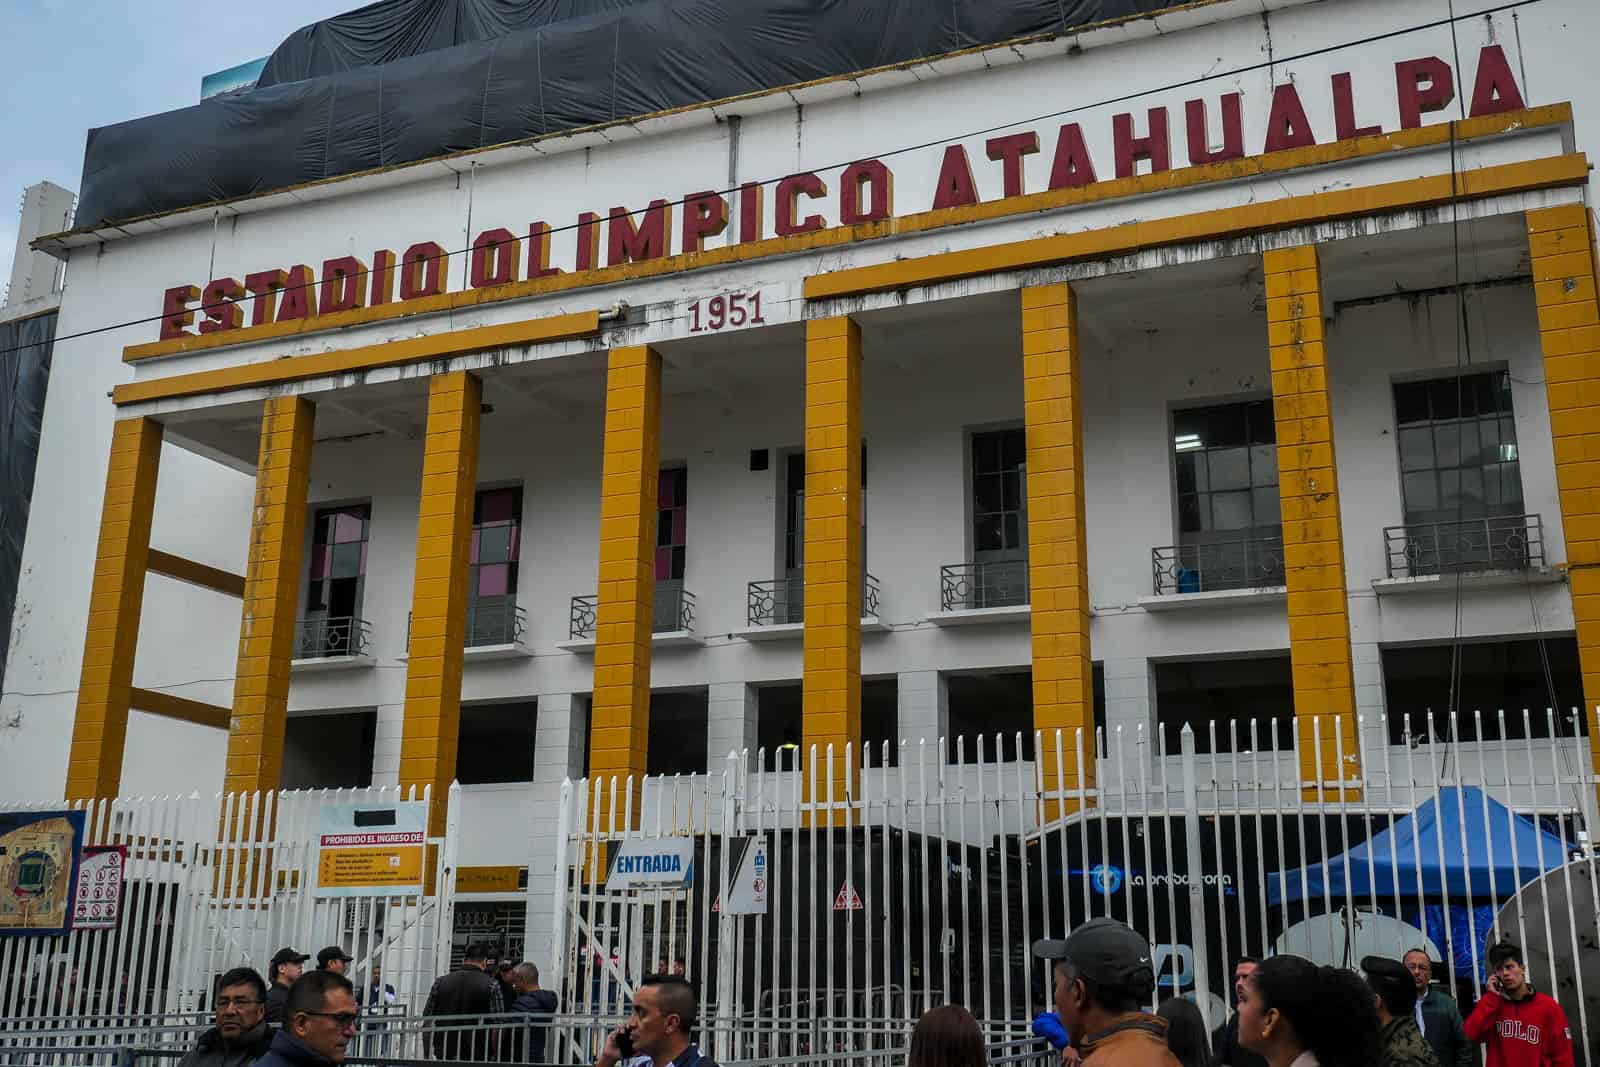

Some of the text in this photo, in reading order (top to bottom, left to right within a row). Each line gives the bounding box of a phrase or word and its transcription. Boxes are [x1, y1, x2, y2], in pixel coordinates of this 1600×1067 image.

[160, 44, 1526, 342] ESTADIO OLIMPICO ATAHUALPA
[325, 834, 366, 845] PROHIBIDO
[367, 834, 376, 843] EL
[377, 833, 410, 843] INGRESO
[616, 854, 681, 873] ENTRADA
